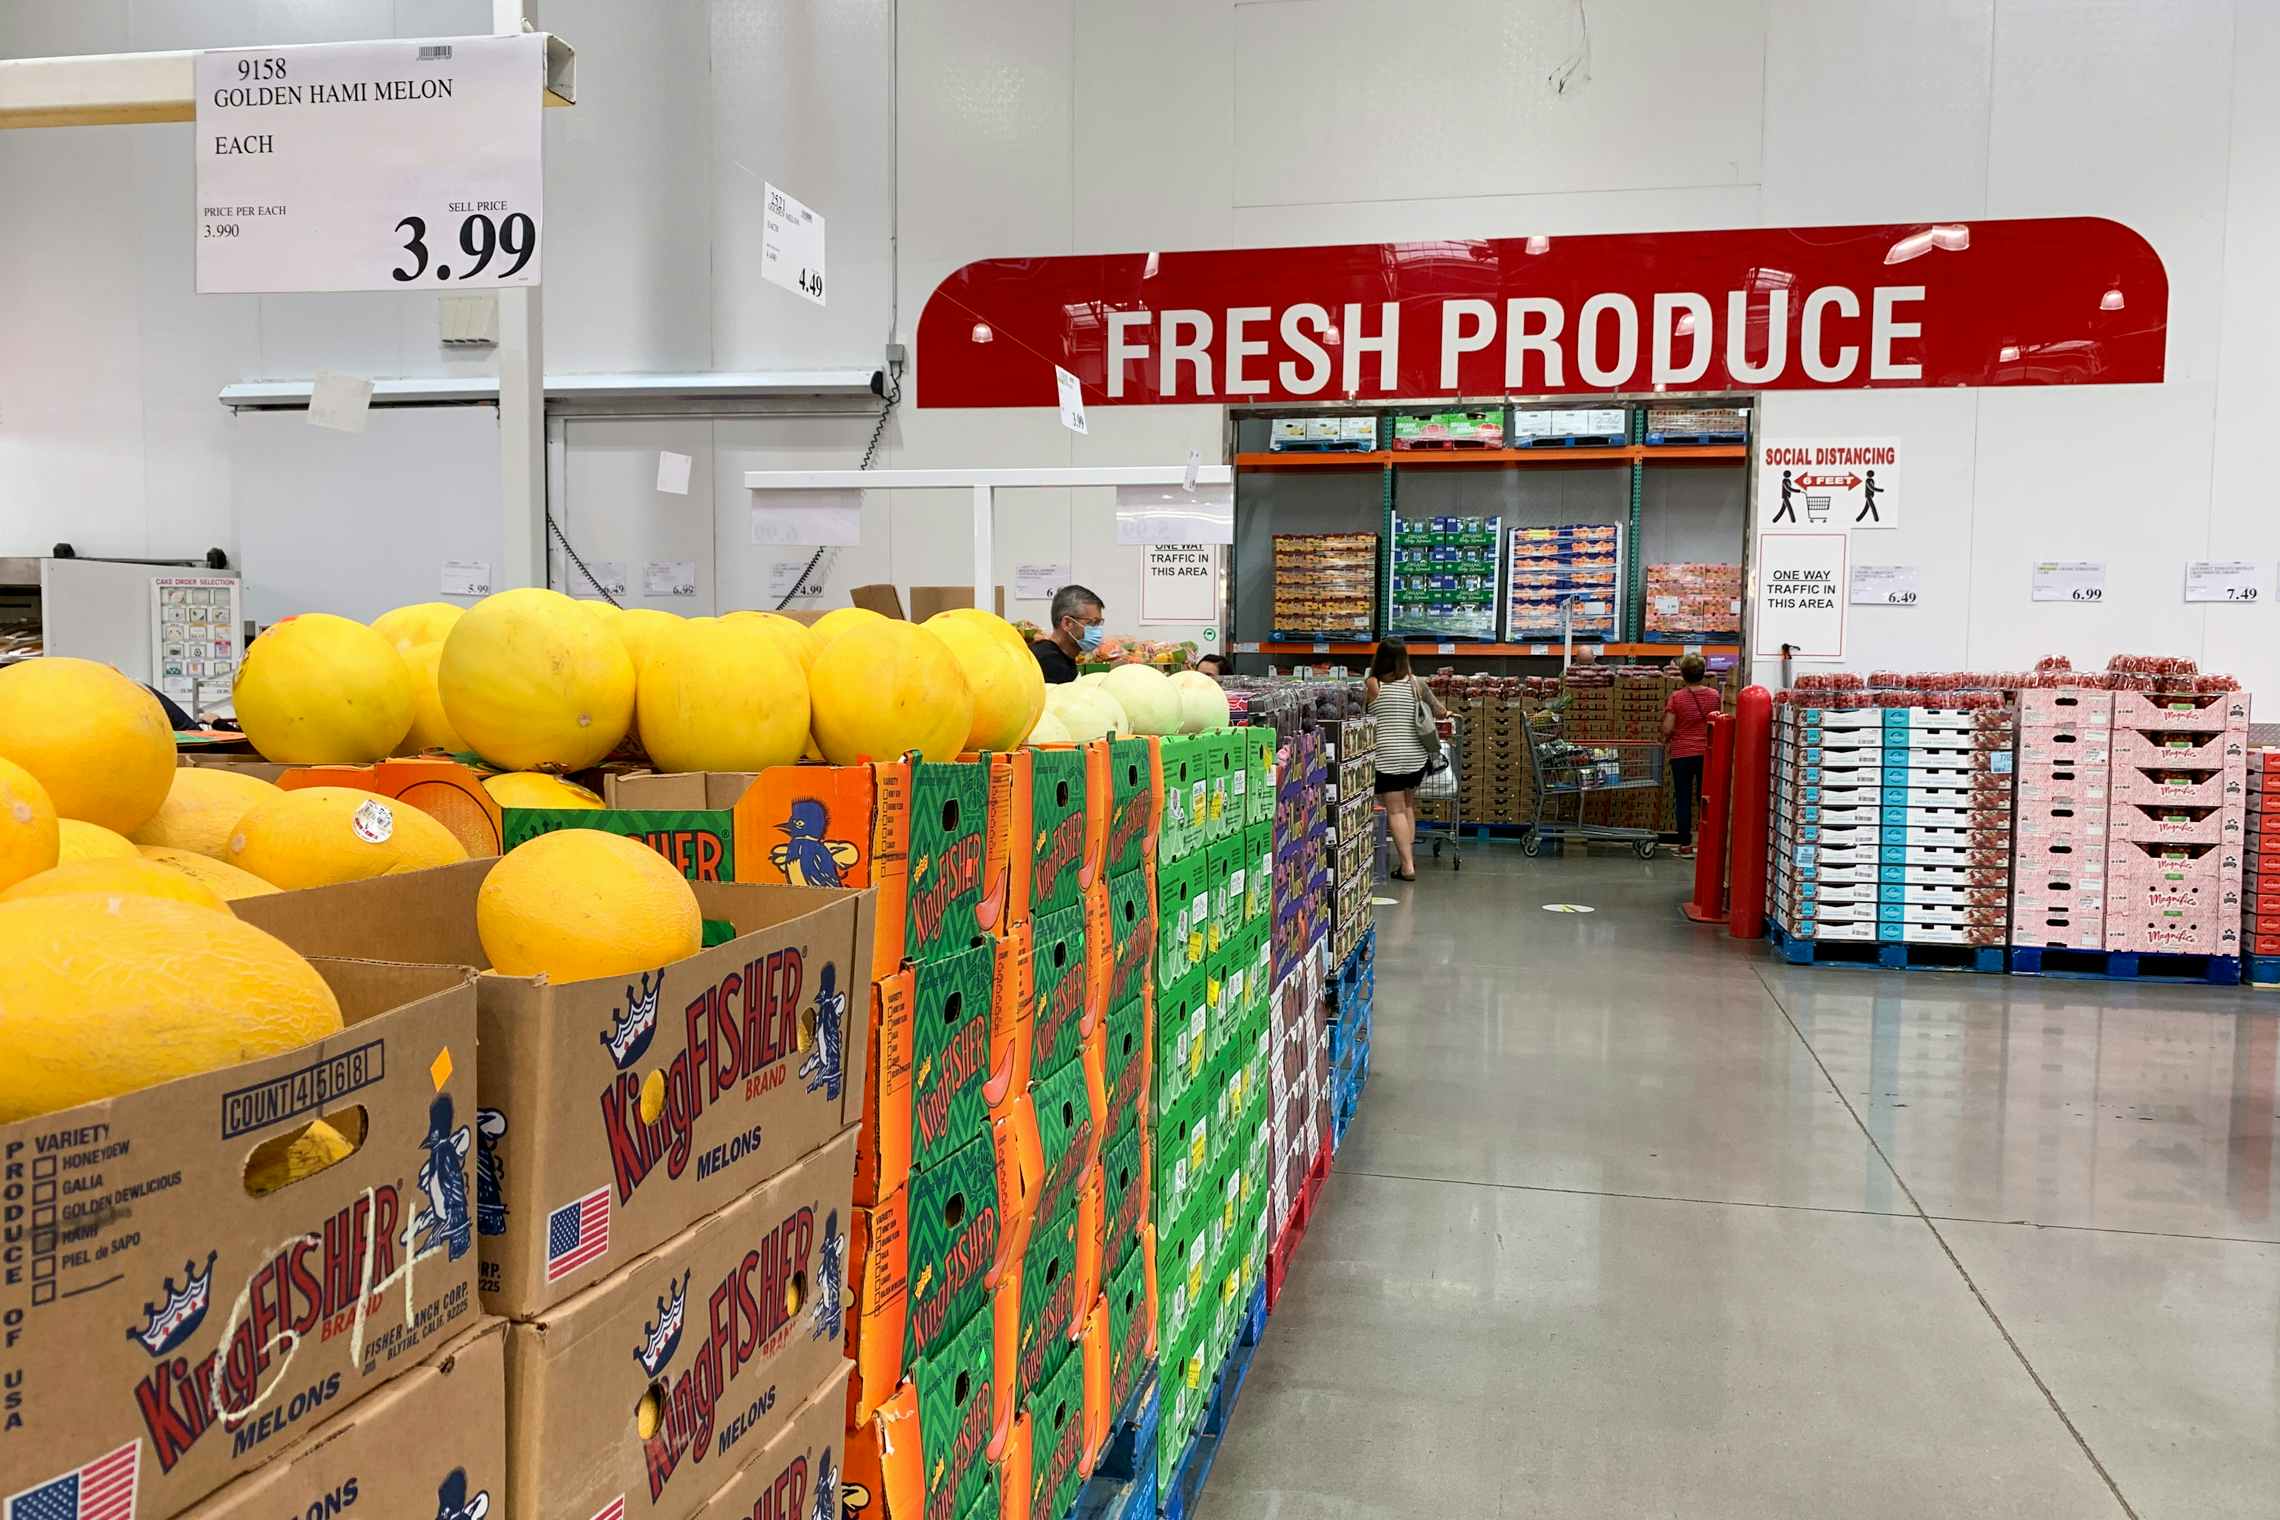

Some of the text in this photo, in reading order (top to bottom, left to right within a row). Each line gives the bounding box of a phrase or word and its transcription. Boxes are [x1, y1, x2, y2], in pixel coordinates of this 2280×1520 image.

[237, 57, 287, 81] 9158
[214, 78, 453, 108] GOLDEN HAMI MELON
[215, 134, 274, 155] EACH
[204, 205, 287, 217] PRICE PER EACH
[448, 200, 508, 213] SELL PRICE
[203, 224, 240, 239] 3.990
[392, 212, 536, 281] 3.99
[799, 267, 823, 297] 4.49
[1107, 285, 1925, 398] FRESH PRODUCE
[1765, 447, 1895, 466] SOCIAL DISTANCING
[1803, 476, 1854, 485] 6 FEET
[1150, 554, 1209, 563] TRAFFIC IN
[1152, 567, 1208, 576] THIS AREA
[467, 584, 488, 593] 5.99
[672, 585, 695, 594] 6.99
[1767, 584, 1836, 595] TRAFFIC IN
[1772, 570, 1831, 580] ONE WAY
[1768, 599, 1834, 608] THIS AREA
[1888, 592, 1916, 603] 6.49
[2072, 588, 2101, 600] 6.99
[2227, 588, 2257, 600] 7.49
[912, 832, 982, 948] KingFISHER
[230, 1055, 362, 1131] COUNT 4 5 6 8
[746, 1064, 785, 1101] BRAND
[917, 1015, 985, 1151] KingFISHER
[35, 1123, 110, 1153] VARIETY
[62, 1139, 130, 1171] HONEYDEW
[697, 1126, 762, 1181] MELONS
[62, 1174, 104, 1195] GALIA
[62, 1196, 112, 1220] GOLDEN
[114, 1170, 182, 1204] DEWLICIOUS
[62, 1231, 141, 1269] PIEL de SAPO
[3, 1141, 24, 1432] PRODUCE OF USA
[912, 1207, 994, 1357] KingFISHER
[134, 1185, 399, 1475] KingFISHER
[364, 1281, 468, 1361] FISHER ANCH CORP.
[232, 1372, 342, 1459] MELONS
[718, 1384, 776, 1457] MELONS
